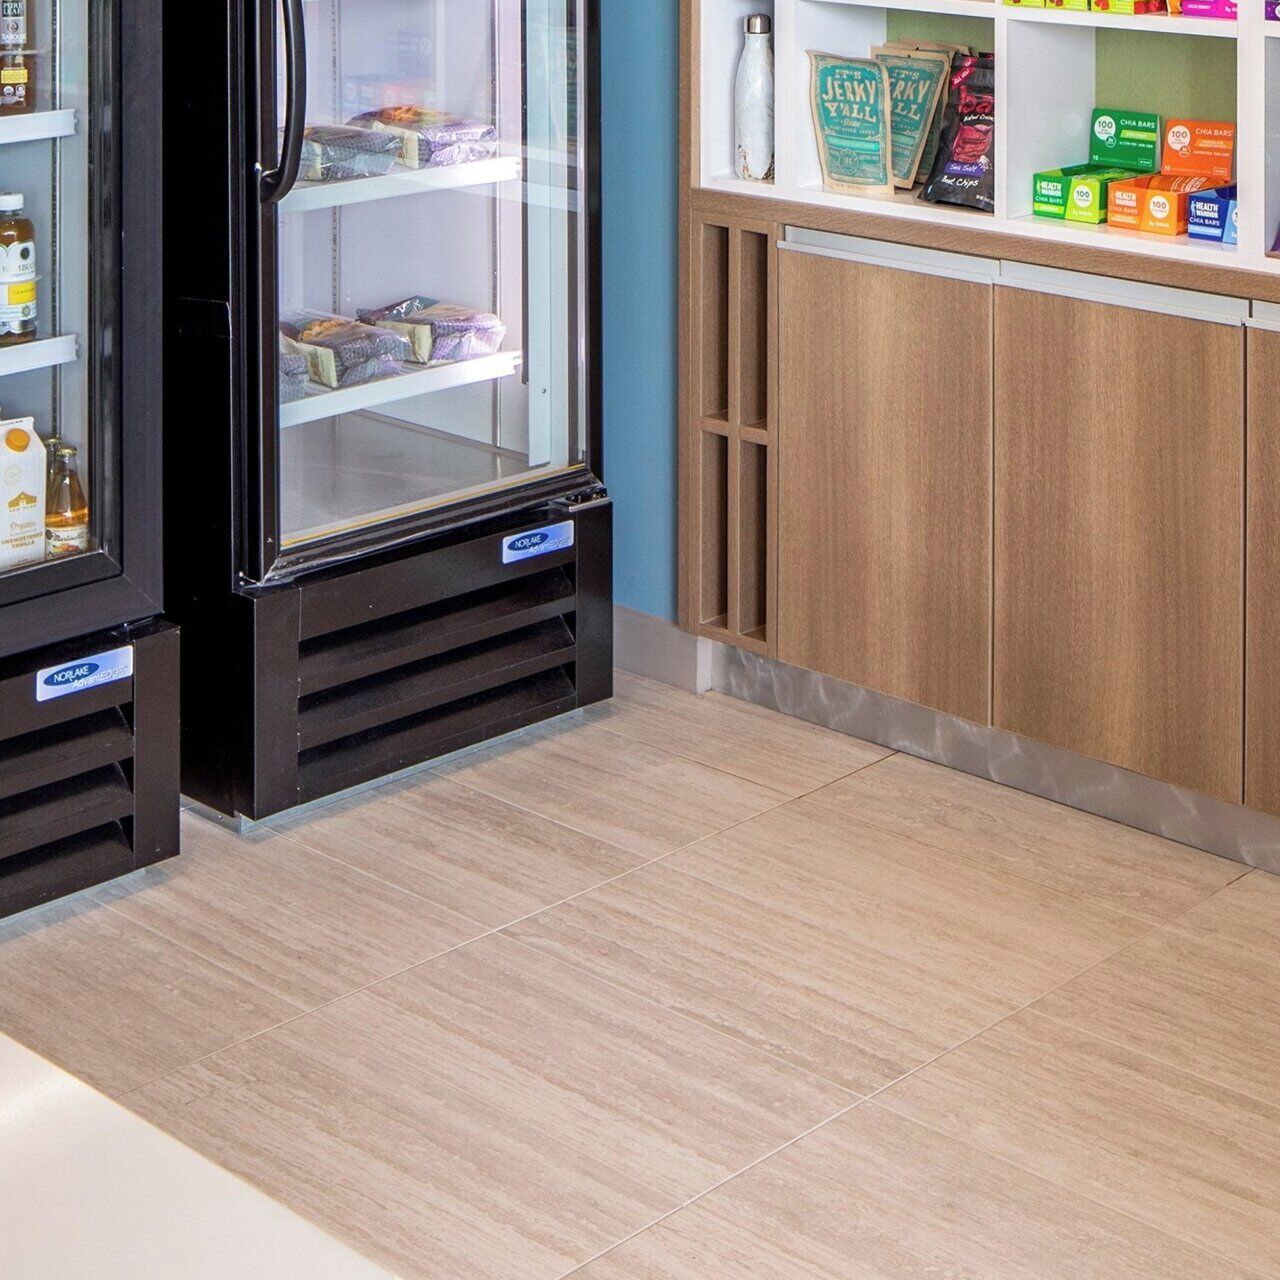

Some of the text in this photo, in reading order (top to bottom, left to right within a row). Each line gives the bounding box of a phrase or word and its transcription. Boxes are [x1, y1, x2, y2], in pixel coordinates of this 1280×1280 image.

[835, 70, 861, 79] IT'S
[822, 77, 876, 104] JERKY
[824, 102, 876, 123] Y'ALL
[1120, 119, 1137, 127] CHIA
[1171, 131, 1187, 139] 100
[957, 178, 979, 187] Chips
[1041, 181, 1062, 190] HEALTH
[1076, 190, 1090, 198] 100
[1115, 192, 1137, 200] HEALTH
[1123, 207, 1138, 215] BARS
[1196, 202, 1219, 212] HEALTH
[1, 532, 43, 544] UNSWEETENED
[515, 535, 541, 548] NORLAKE
[11, 540, 35, 549] VANILLA
[54, 666, 89, 683] NORLAKE
[73, 665, 128, 688] AdvantEDGE
